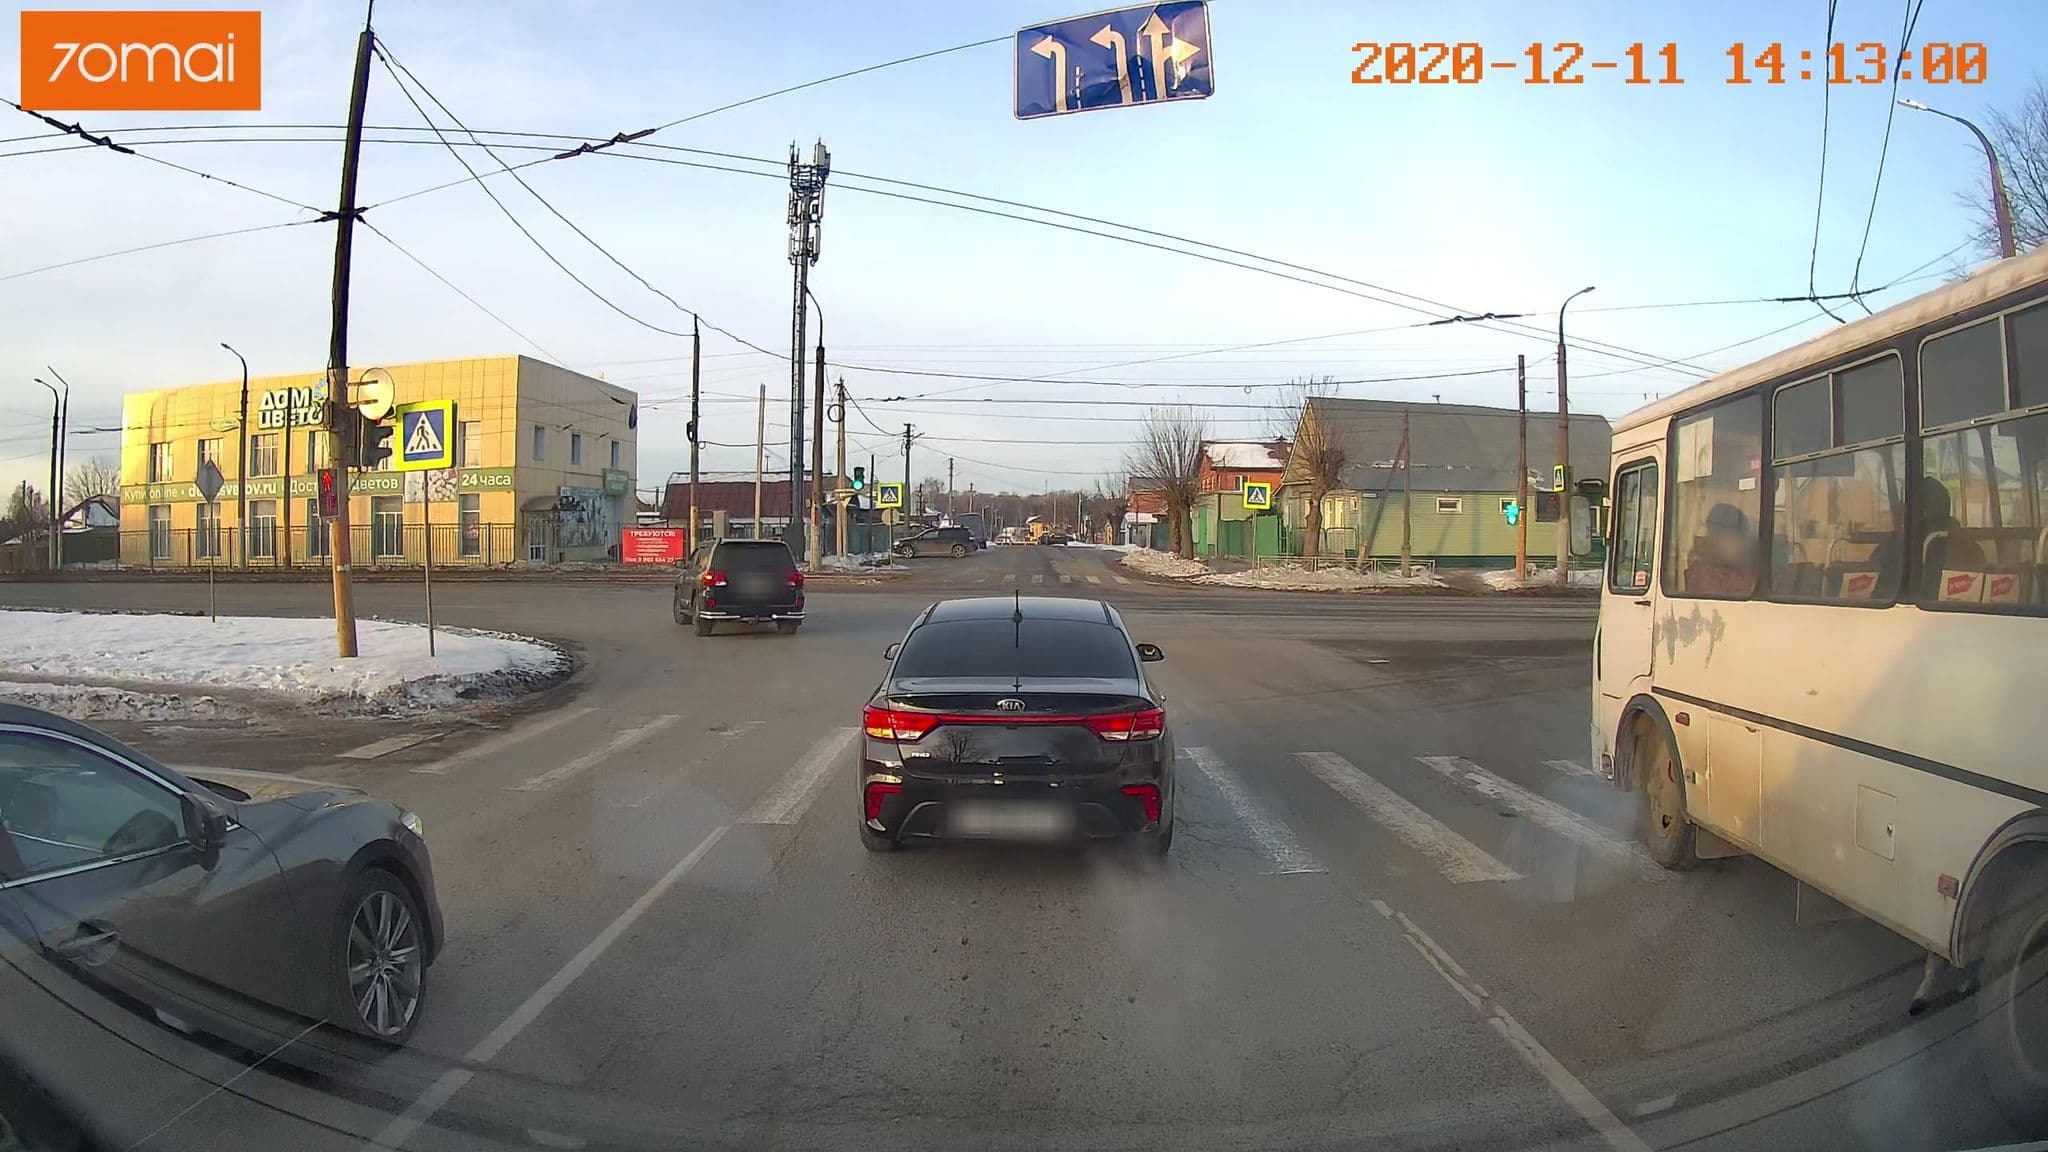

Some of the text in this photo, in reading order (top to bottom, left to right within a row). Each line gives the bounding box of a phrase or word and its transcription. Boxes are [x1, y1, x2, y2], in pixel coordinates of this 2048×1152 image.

[259, 387, 312, 409] ДОМ
[258, 407, 324, 430] ЦВЕТО
[461, 474, 511, 487] 24 часа
[1002, 701, 1021, 710] KIA
